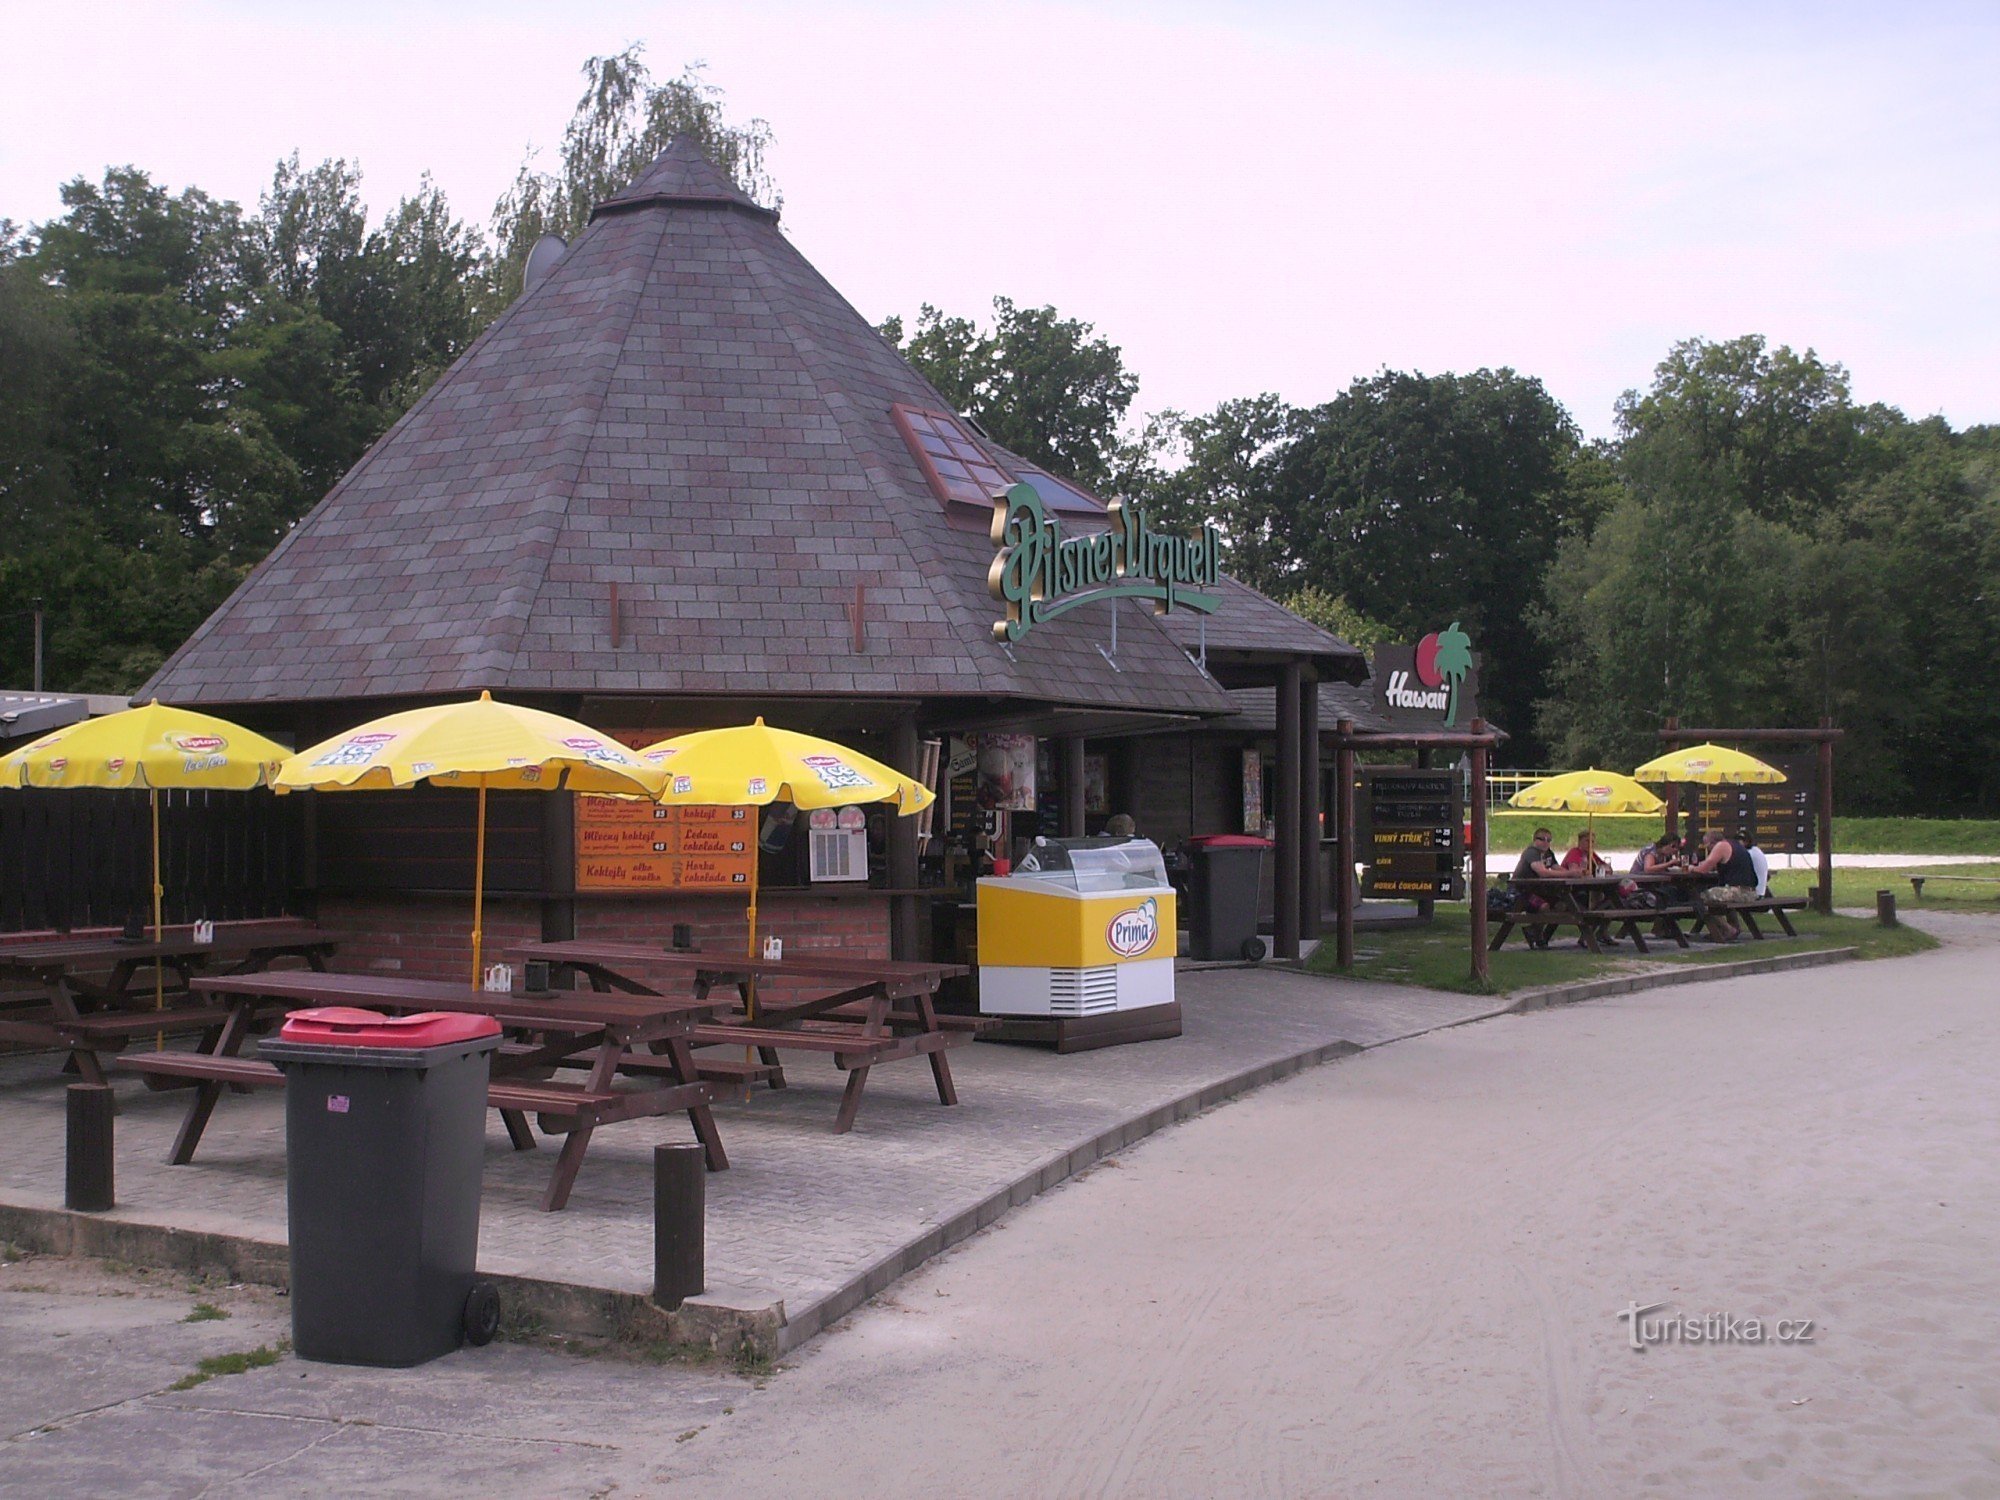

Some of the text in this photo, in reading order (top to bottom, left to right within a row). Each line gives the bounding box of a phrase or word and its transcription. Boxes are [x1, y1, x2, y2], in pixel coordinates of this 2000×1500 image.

[991, 482, 1220, 642] Pilsner Urquell
[1385, 670, 1450, 710] Hawaii
[179, 738, 222, 748] Lipton
[1115, 920, 1149, 943] Prima
